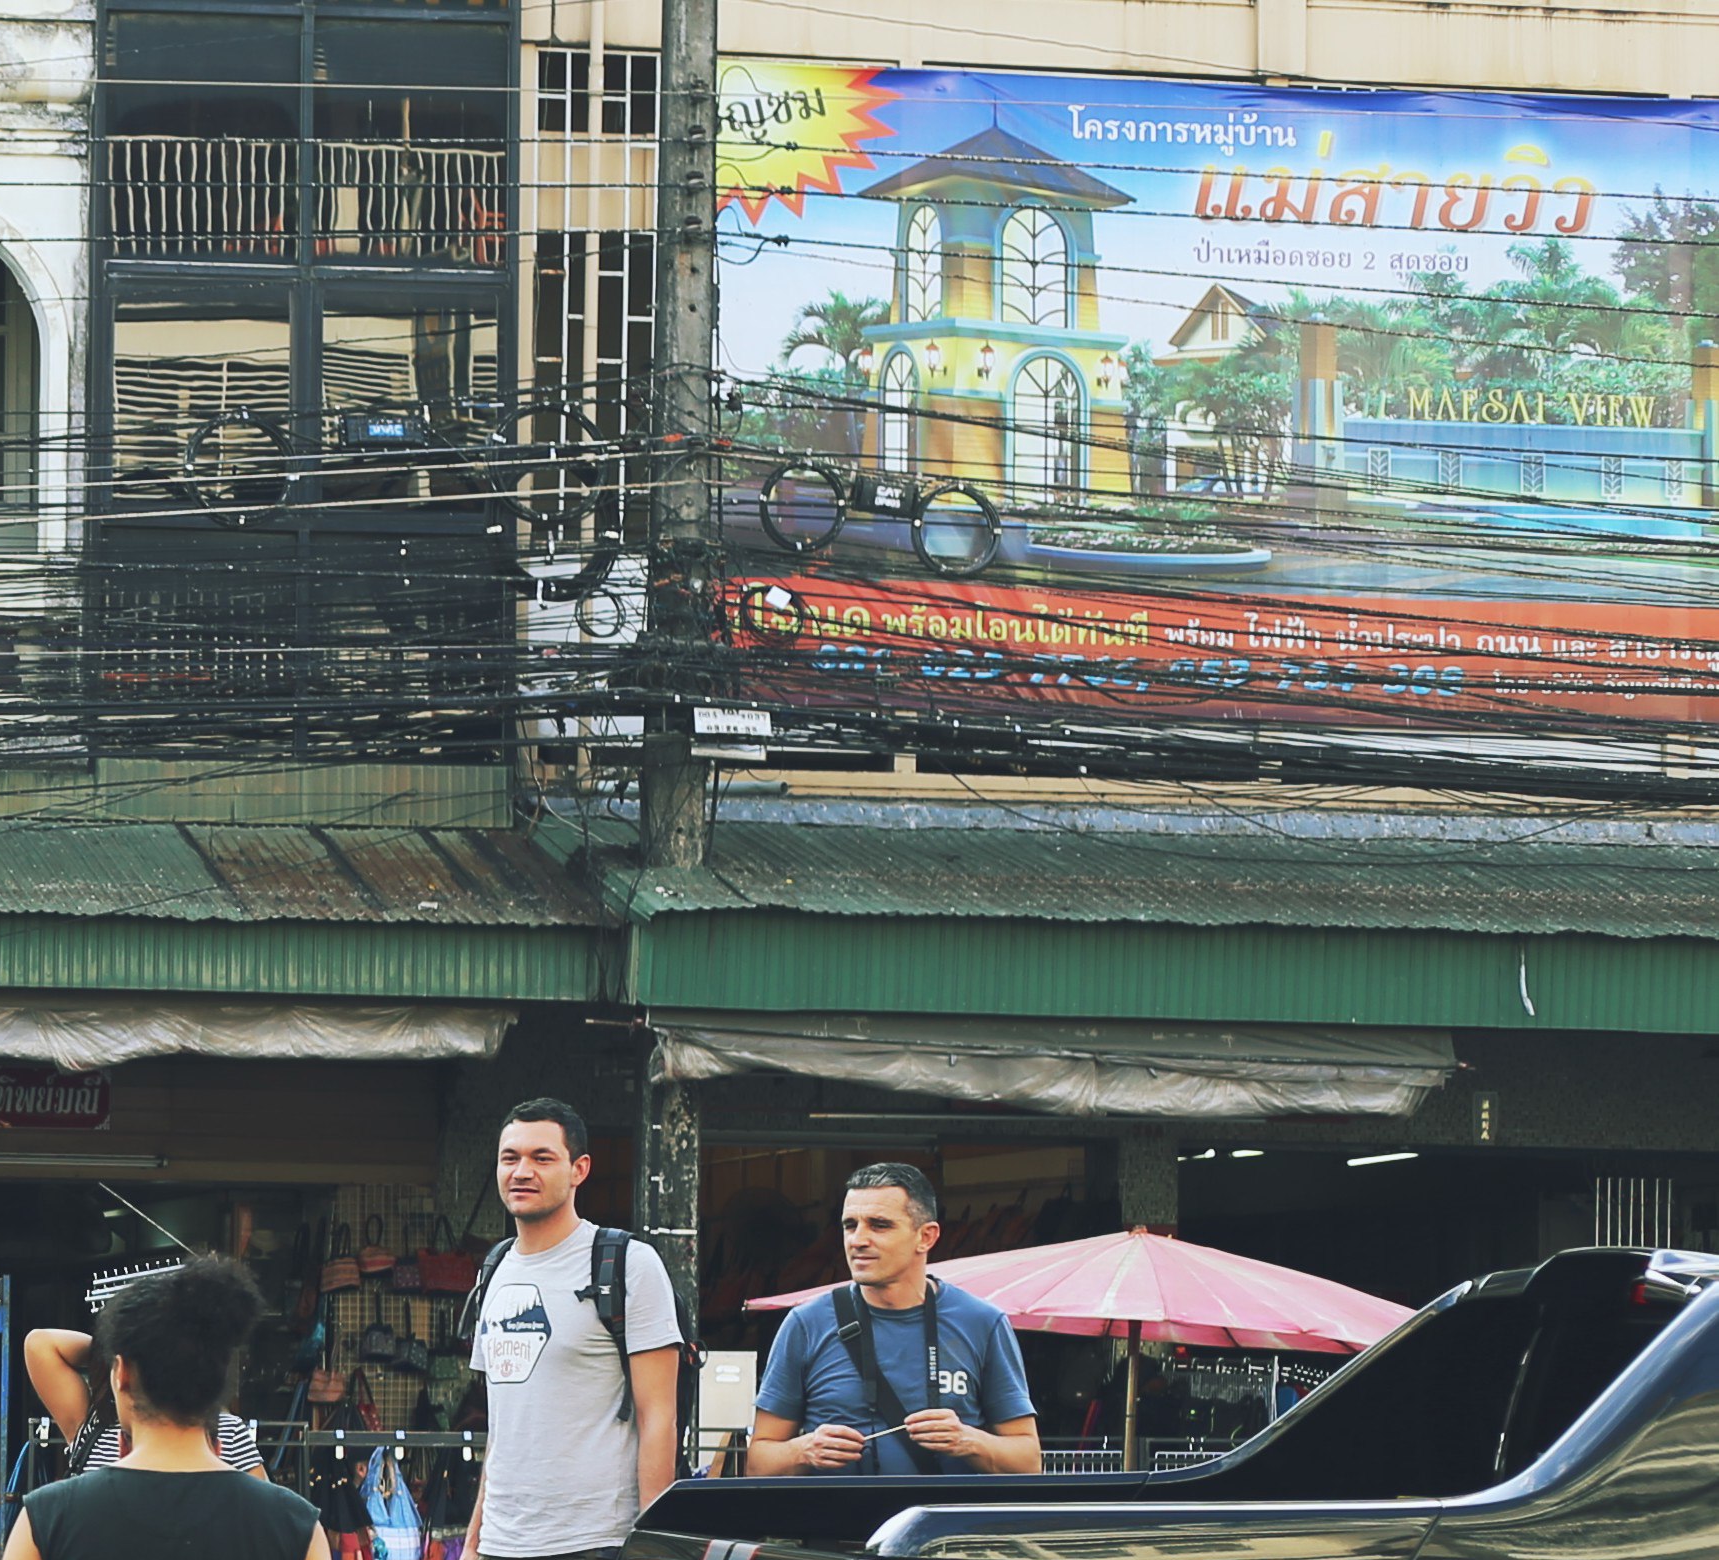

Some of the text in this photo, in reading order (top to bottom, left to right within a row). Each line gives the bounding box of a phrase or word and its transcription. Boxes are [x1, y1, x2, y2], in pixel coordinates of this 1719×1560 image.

[1067, 104, 1297, 156] โครงการหมู่บ้าน
[1193, 130, 1597, 235] แม่สายวิว
[1192, 236, 1470, 280] ป่าเหมือดซอย 2 สุดซอย
[1566, 392, 1656, 428] VIEW
[487, 1337, 531, 1369] Element
[938, 1370, 968, 1395] 96
